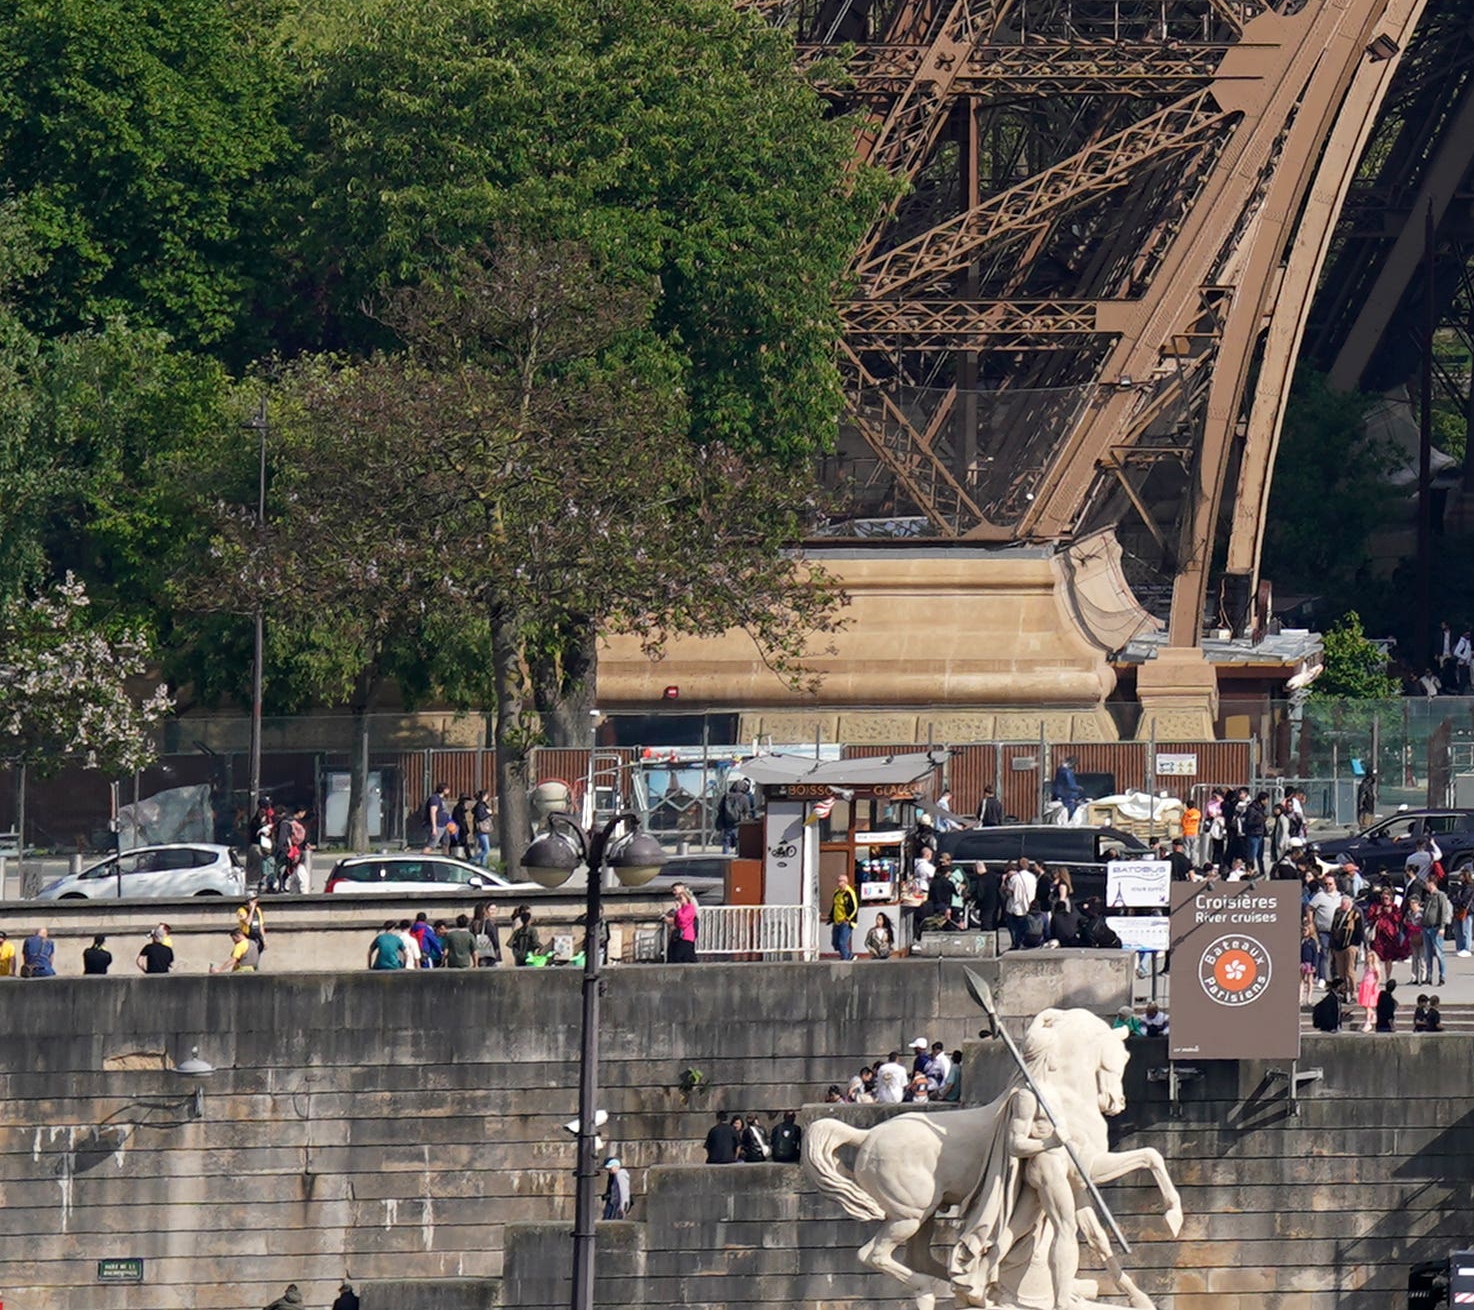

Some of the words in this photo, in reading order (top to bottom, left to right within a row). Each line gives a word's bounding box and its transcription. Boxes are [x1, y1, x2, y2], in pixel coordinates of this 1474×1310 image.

[788, 785, 835, 796] BOISSO
[1195, 894, 1278, 909] Croisières
[1195, 911, 1227, 923] River
[1231, 911, 1277, 923] cruises
[1204, 940, 1265, 966] Bateaux
[1204, 975, 1267, 1002] Parisiens
